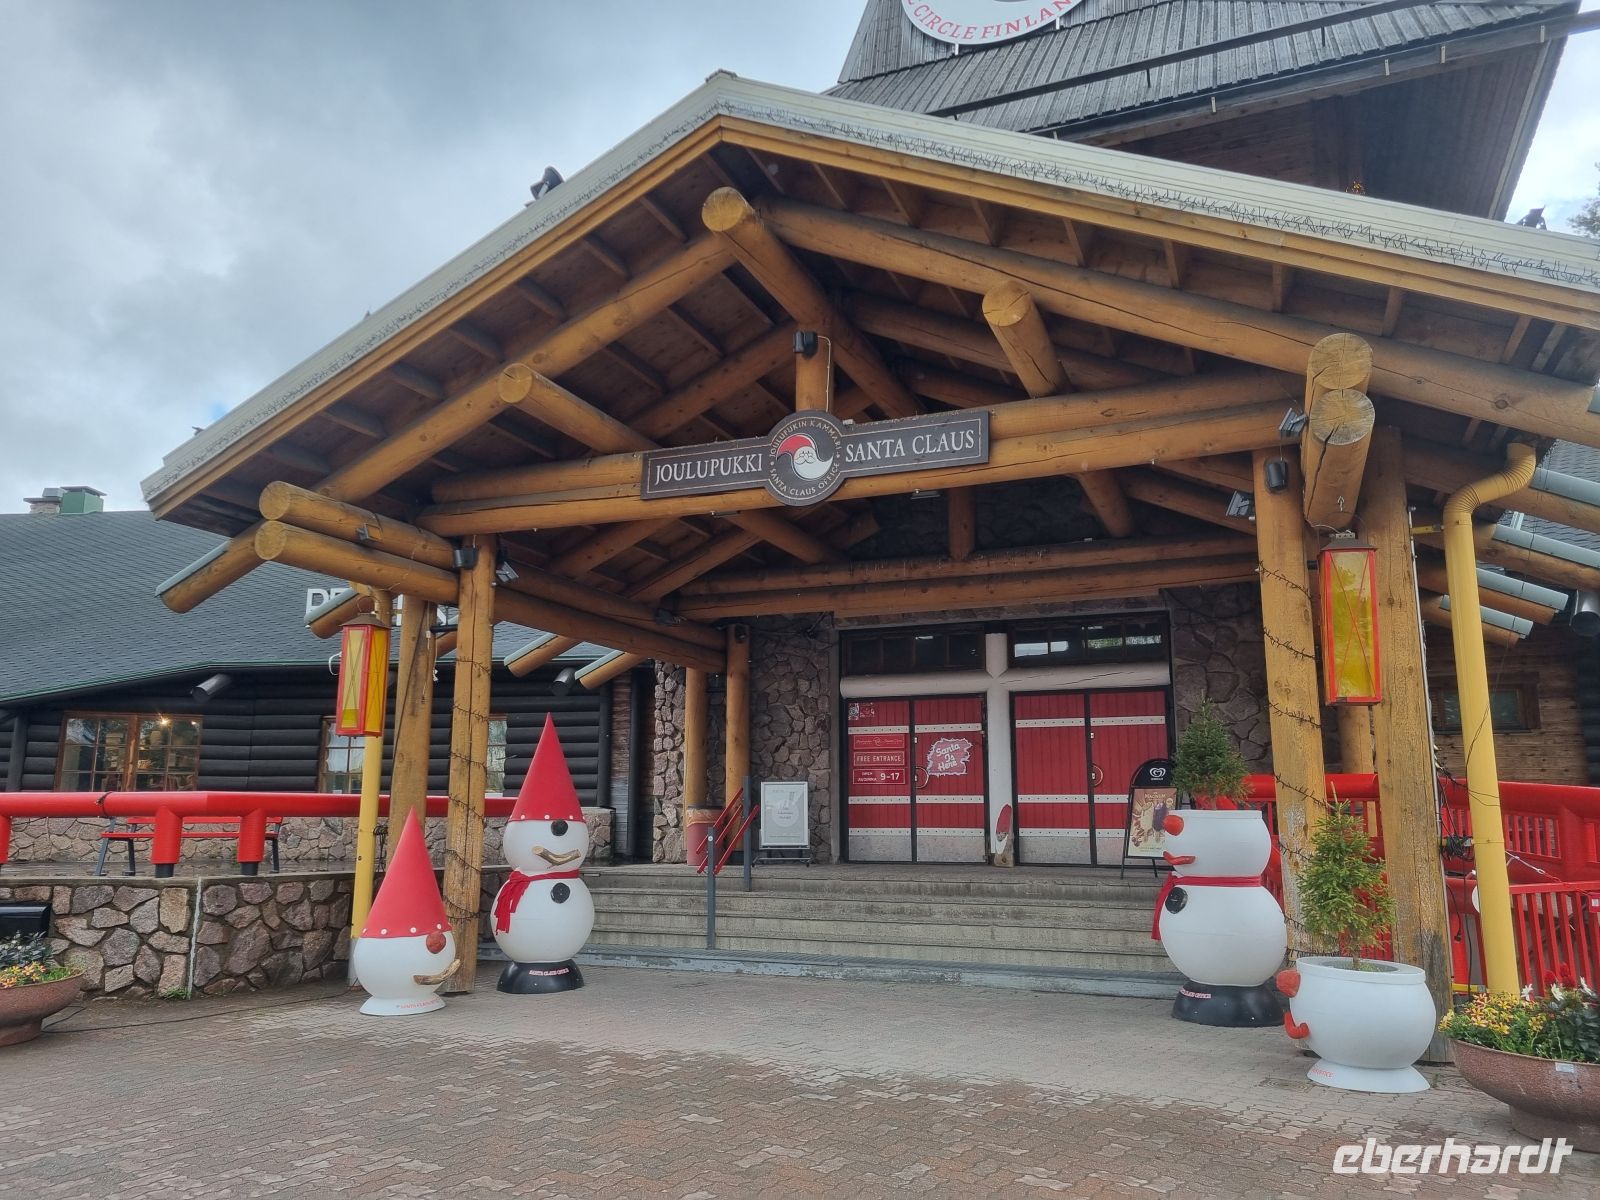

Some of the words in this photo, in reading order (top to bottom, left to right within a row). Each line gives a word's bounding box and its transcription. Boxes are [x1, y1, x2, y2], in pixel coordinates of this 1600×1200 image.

[913, 4, 977, 39] CIRCLE
[769, 420, 808, 458] JOULUPUKIN
[809, 419, 843, 451] KAMMARI
[845, 438, 905, 462] SANTA
[912, 429, 974, 455] CLAUS
[655, 453, 762, 485] JOULUPUKKI
[769, 468, 788, 492] SANTA
[789, 487, 816, 496] CLAUS
[818, 462, 840, 489] OFFICE
[873, 754, 902, 762] ENTRANCE
[935, 743, 960, 757] Santa
[944, 754, 956, 763] Is
[880, 772, 900, 781] 9-17
[937, 760, 957, 772] Here
